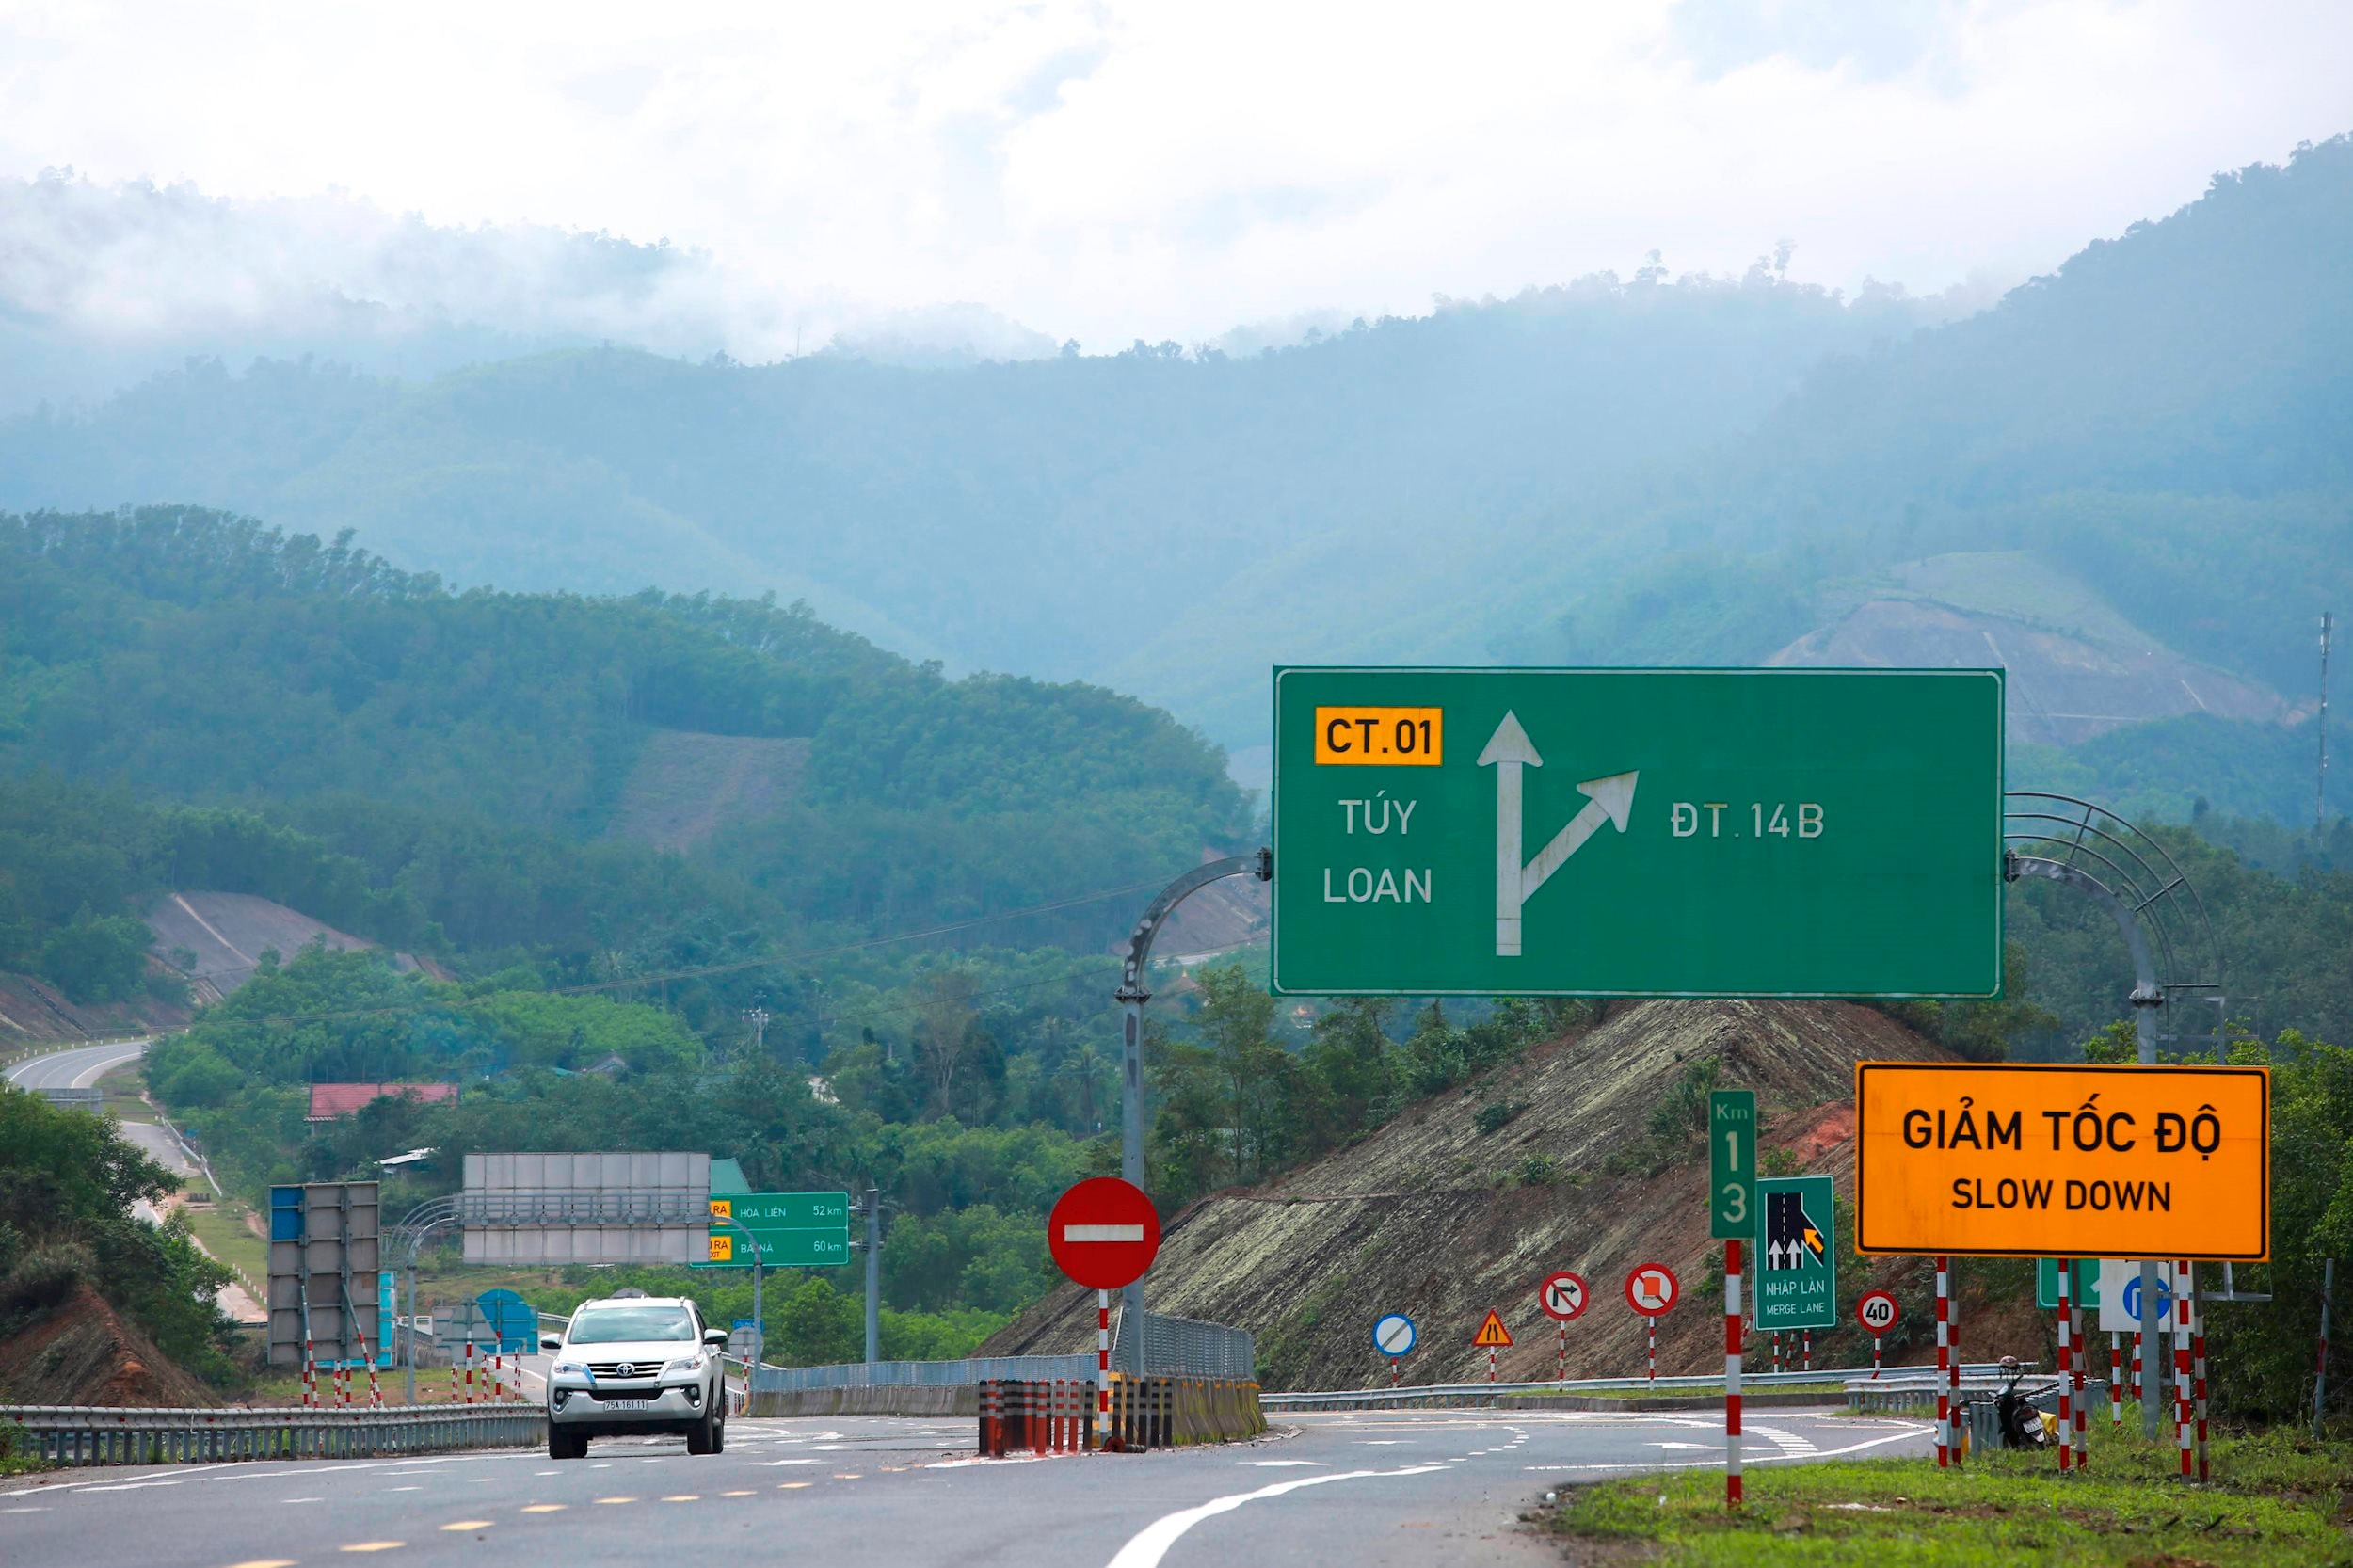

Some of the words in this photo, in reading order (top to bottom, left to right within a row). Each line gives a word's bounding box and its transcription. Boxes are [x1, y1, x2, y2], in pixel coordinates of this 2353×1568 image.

[1325, 718, 1433, 755] CT.01
[1338, 790, 1417, 835] TÚY
[1323, 868, 1433, 904] LOAN
[1716, 1103, 1749, 1121] Km
[1903, 1096, 2023, 1152] GIẢM
[2042, 1093, 2136, 1153] TỐC
[2153, 1103, 2222, 1162] ĐỘ
[1951, 1178, 2054, 1209] SLOW
[2066, 1180, 2172, 1212] DOWN
[713, 1206, 727, 1214] RA
[813, 1206, 826, 1216] 52
[827, 1207, 842, 1216] km
[814, 1240, 826, 1252] 60
[828, 1242, 842, 1252] km
[1766, 1279, 1797, 1298] NHẬP
[1801, 1277, 1825, 1295] LÀN
[1766, 1304, 1797, 1316] MERGE
[1800, 1303, 1825, 1314] LANE
[1865, 1303, 1890, 1321] 40
